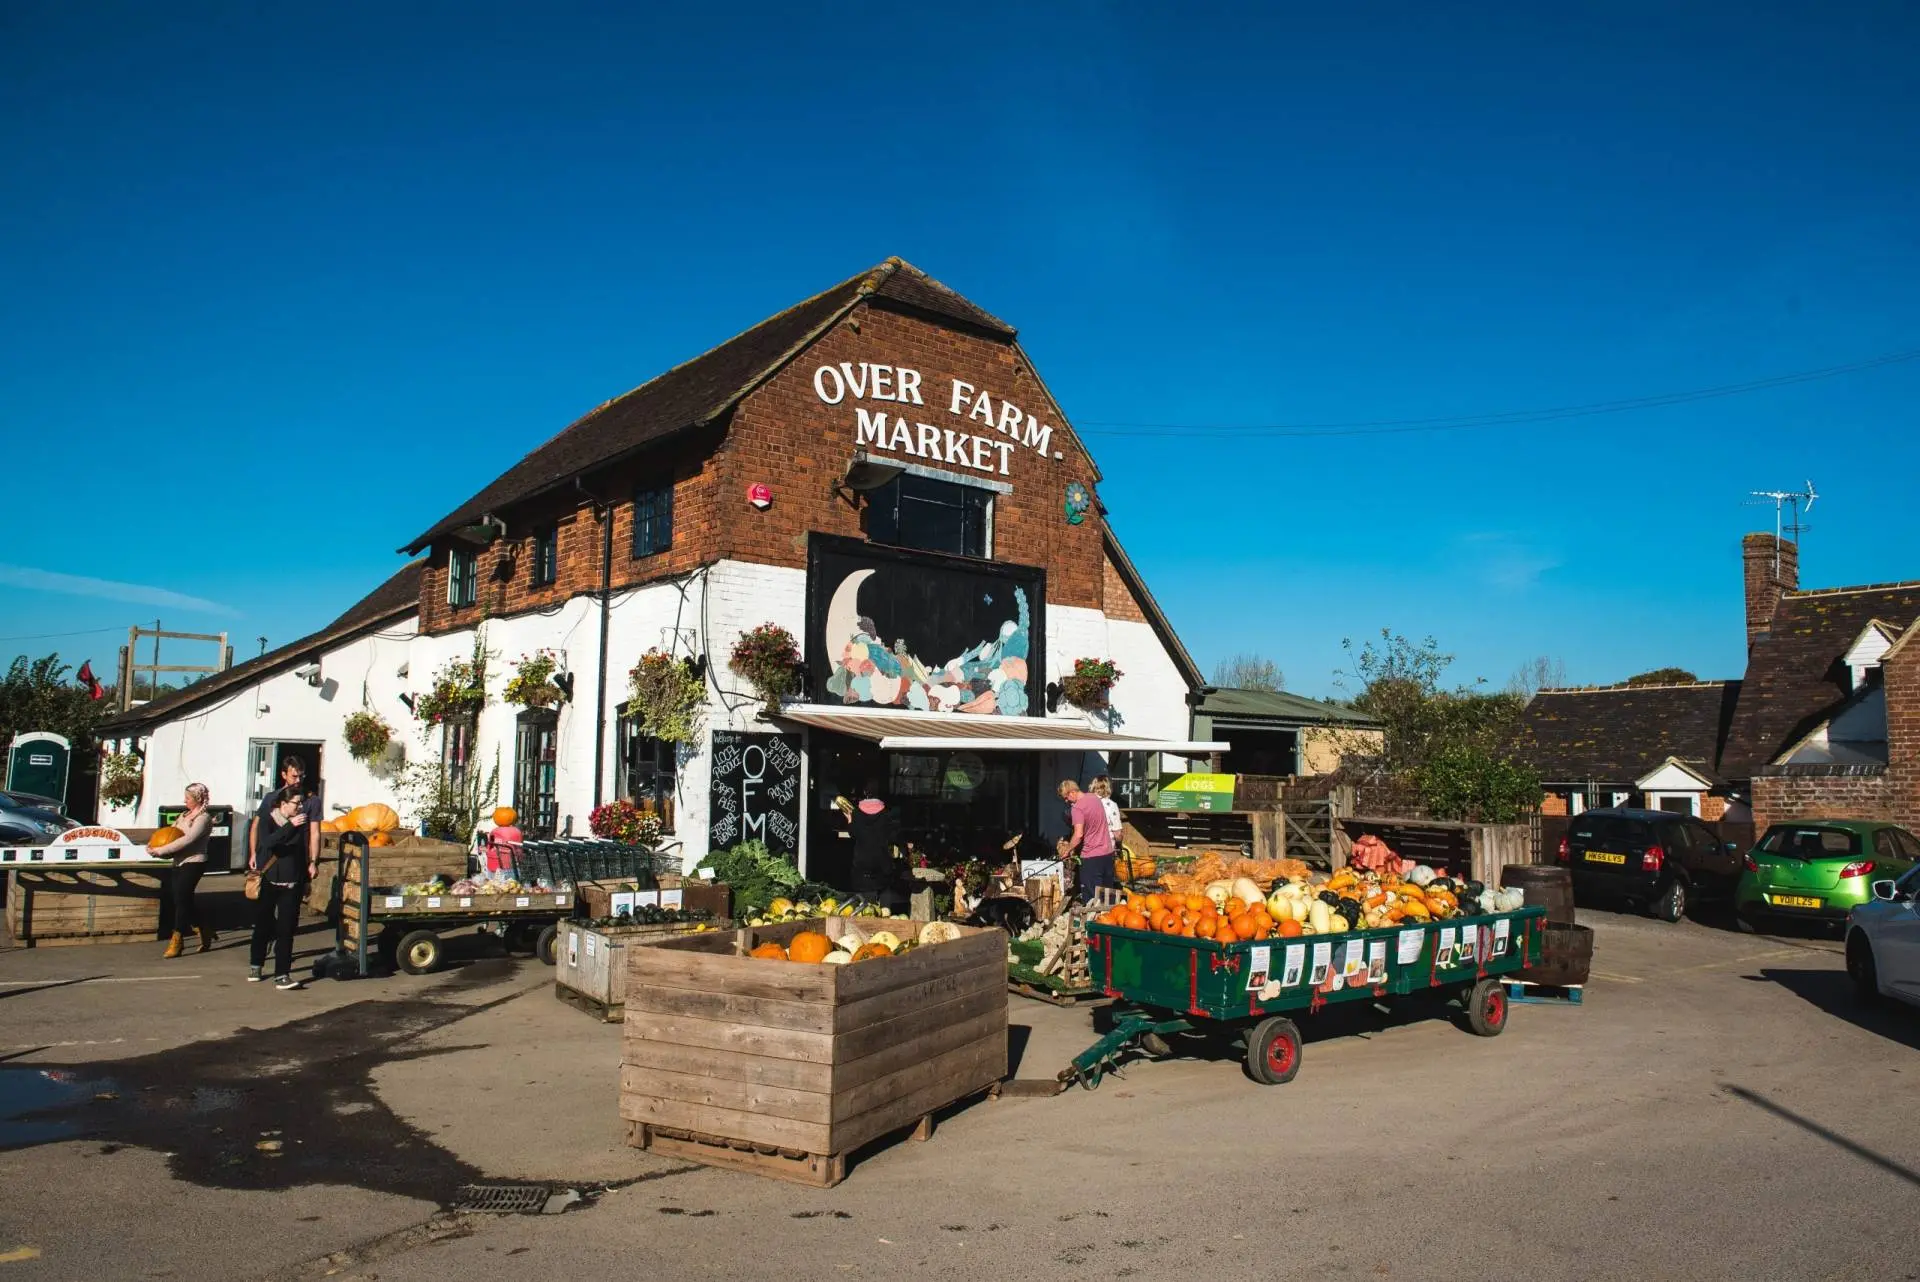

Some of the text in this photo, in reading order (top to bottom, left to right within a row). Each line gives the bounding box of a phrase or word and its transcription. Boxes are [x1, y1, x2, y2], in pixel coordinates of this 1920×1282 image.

[814, 362, 1054, 459] OVER FARM
[855, 408, 1015, 476] MARKET
[713, 744, 741, 766] LOCAL
[769, 736, 801, 769] BUTCHERY
[770, 753, 788, 776] DELI
[712, 754, 743, 779] PRODUCE
[711, 779, 737, 799] CRAFT
[717, 796, 737, 813] ALES
[710, 812, 741, 839] SEASONAL
[767, 809, 798, 835] ARTISAN
[767, 818, 796, 849] PRODUCTS
[716, 825, 738, 845] EVENTS
